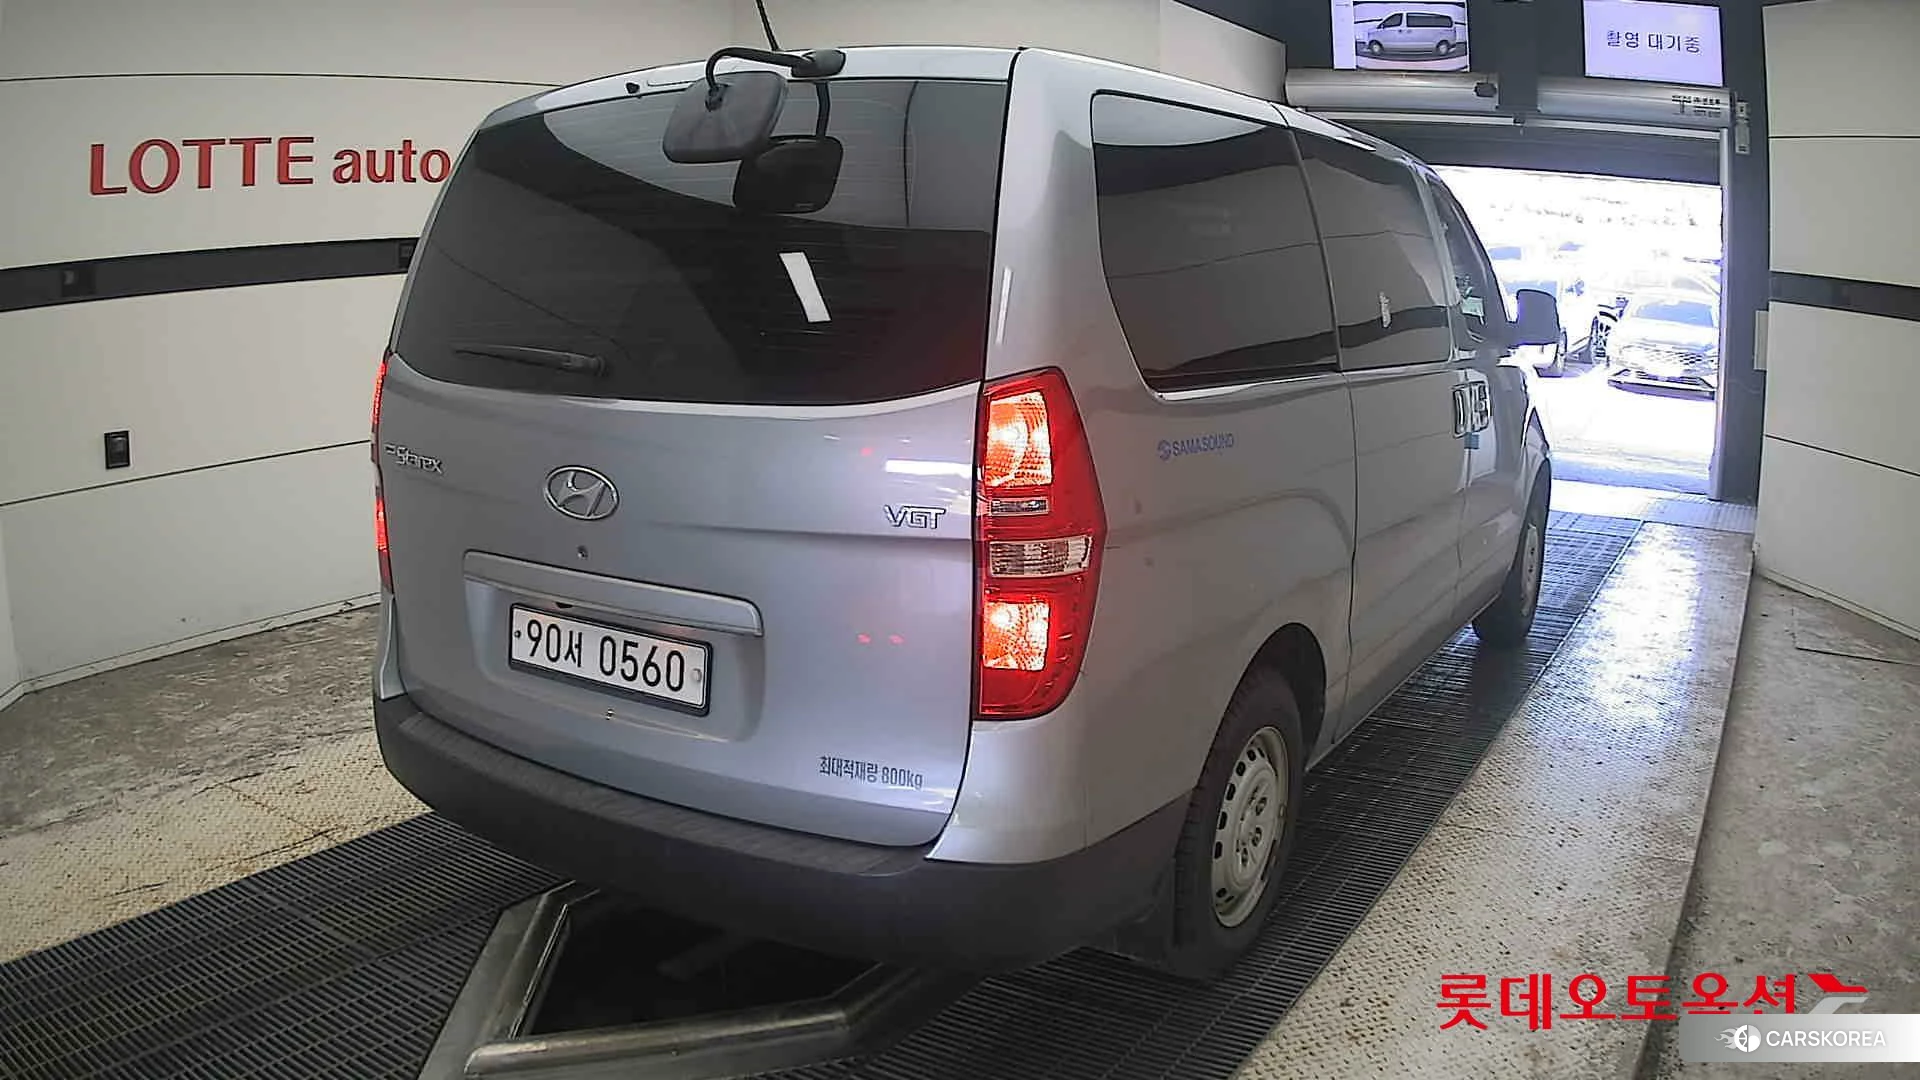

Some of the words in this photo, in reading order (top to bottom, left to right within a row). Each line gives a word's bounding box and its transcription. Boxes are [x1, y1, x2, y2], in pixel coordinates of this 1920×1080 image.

[1648, 33, 1700, 53] 대기중
[89, 136, 314, 196] LOTTE
[332, 139, 452, 185] auto
[883, 504, 947, 530] VGT
[527, 619, 582, 668] 90서
[600, 635, 685, 692] 0560
[819, 756, 878, 784] 최대적재량
[881, 766, 923, 790] 800kg
